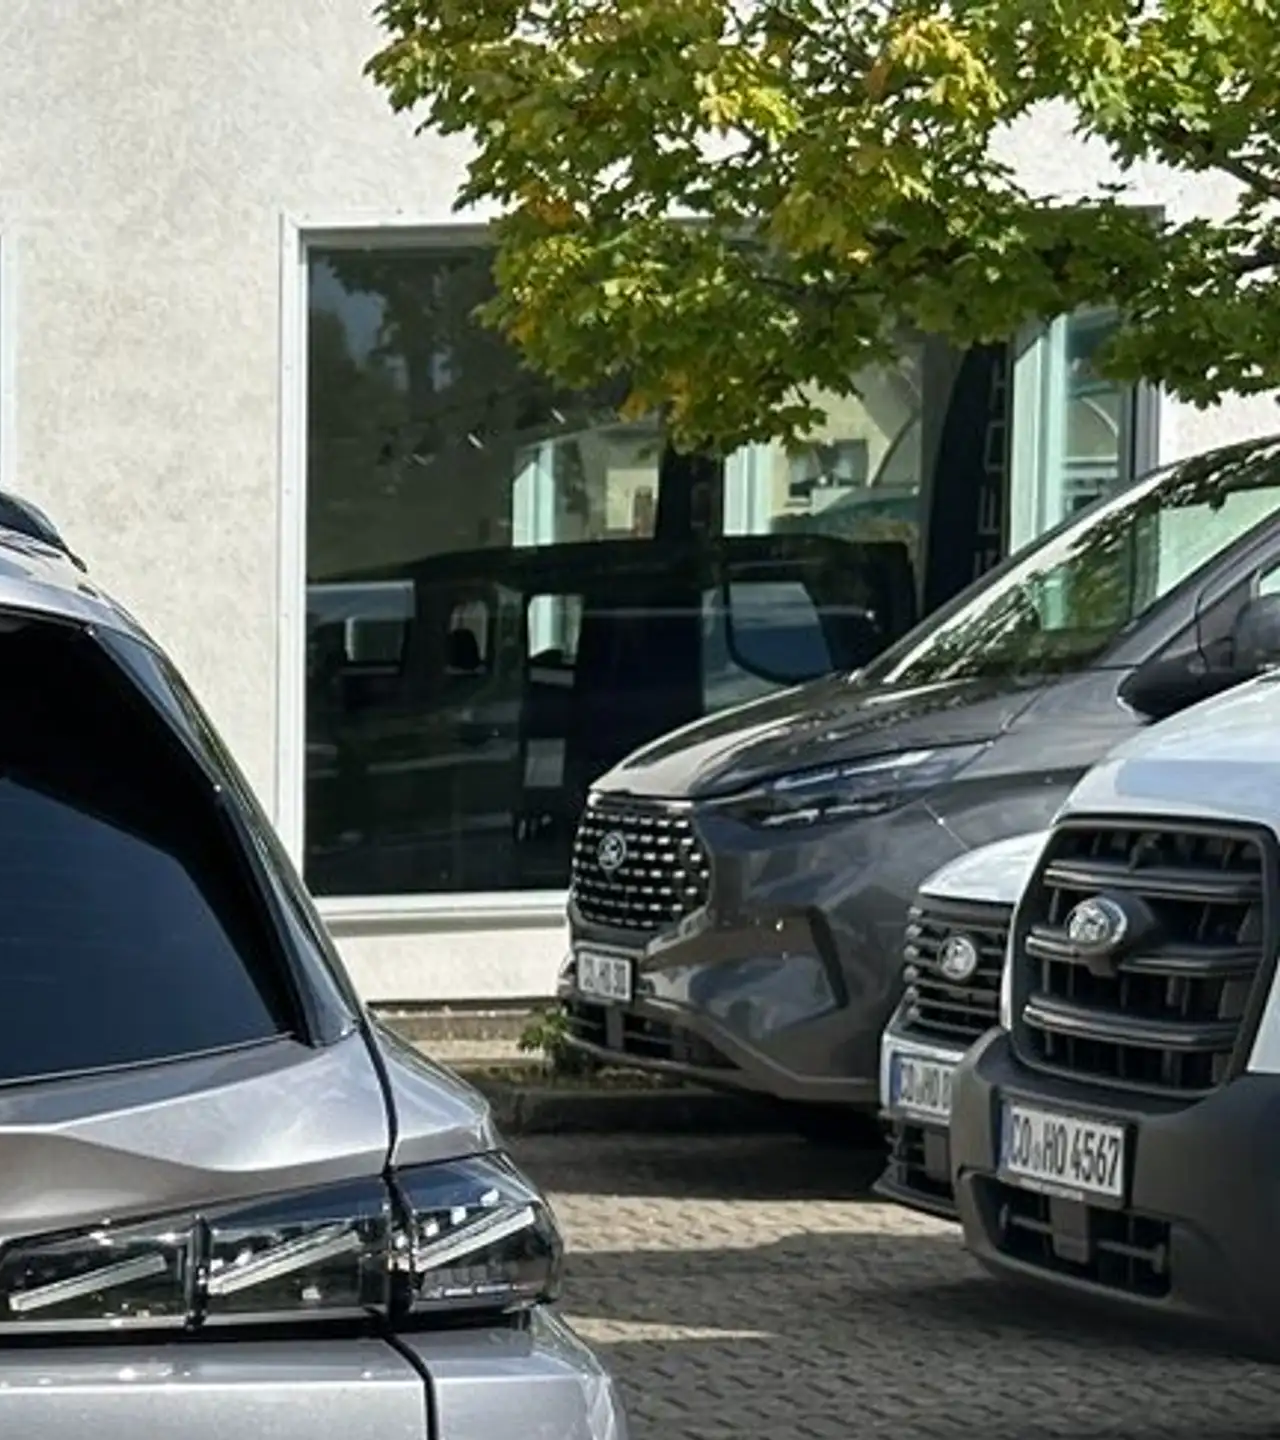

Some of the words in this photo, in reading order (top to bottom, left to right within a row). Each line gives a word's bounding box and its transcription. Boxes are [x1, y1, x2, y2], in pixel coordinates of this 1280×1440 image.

[1010, 1112, 1033, 1168] CO
[1042, 1120, 1068, 1176] HO
[1070, 1126, 1120, 1188] 4567
